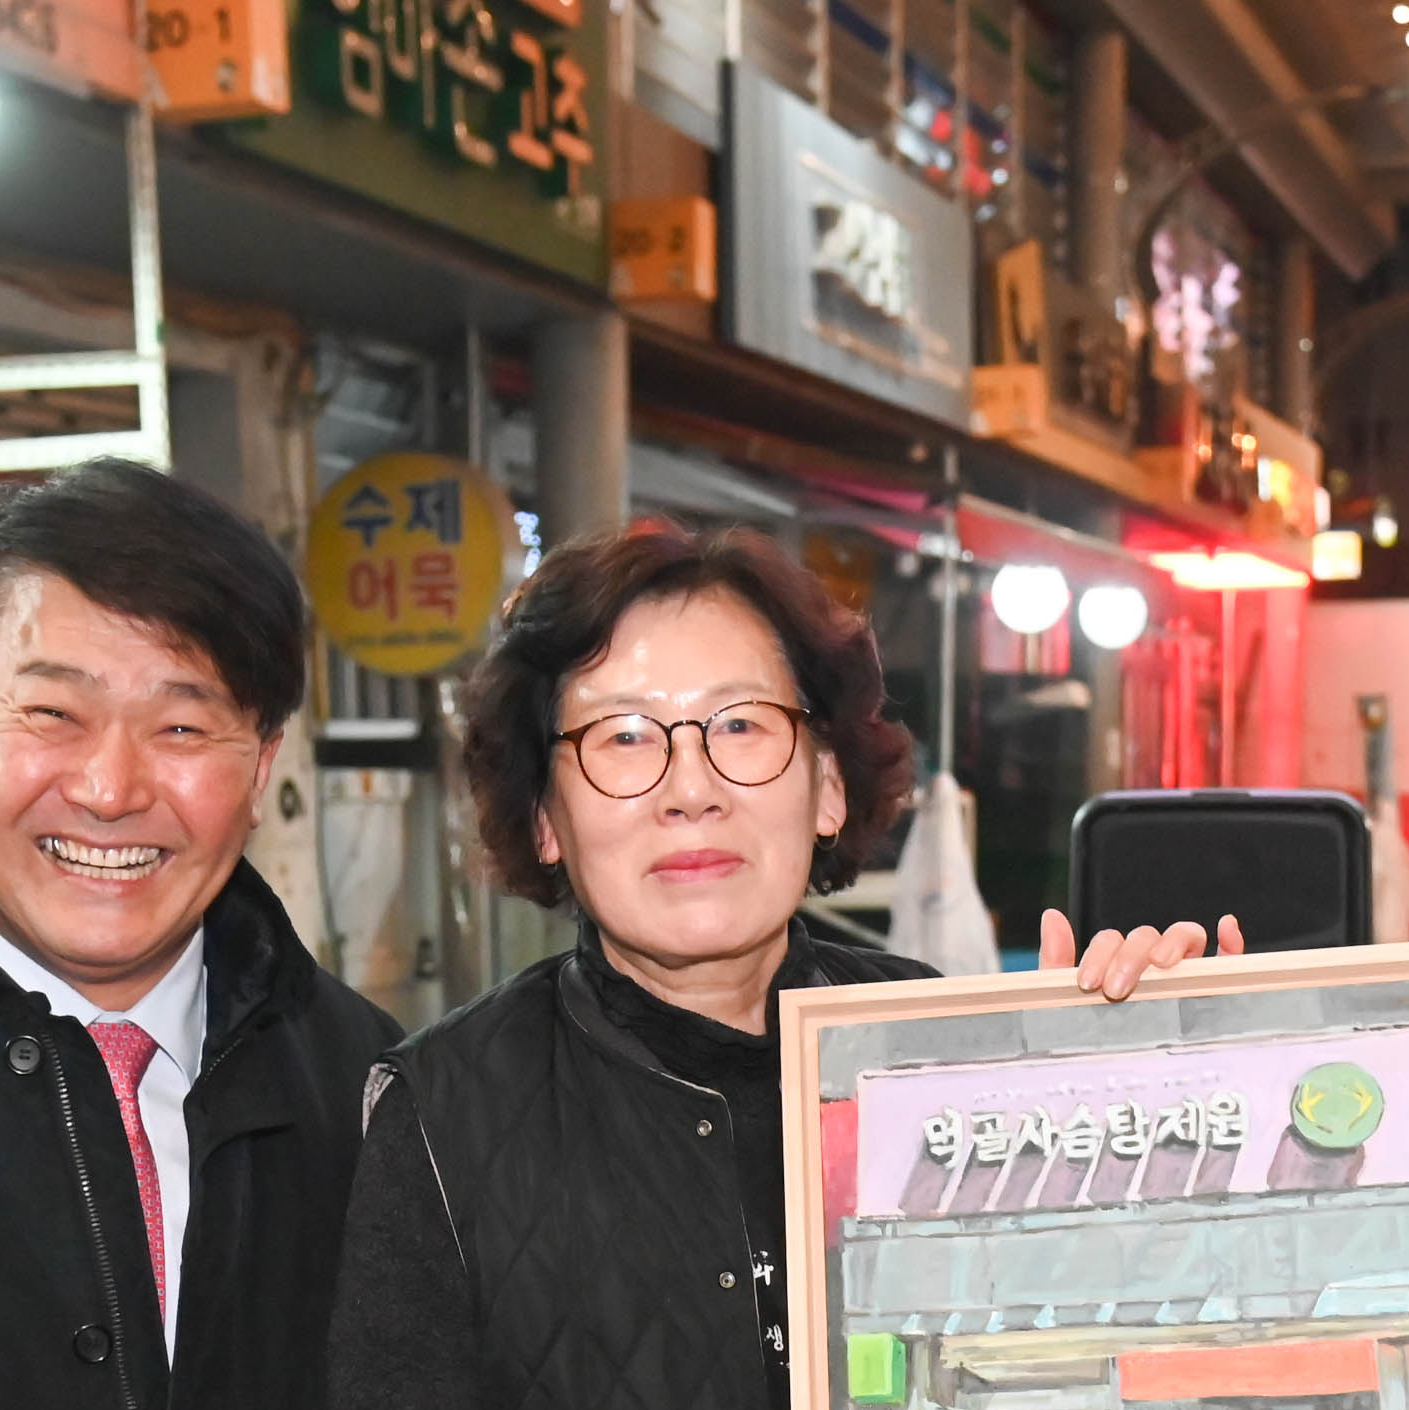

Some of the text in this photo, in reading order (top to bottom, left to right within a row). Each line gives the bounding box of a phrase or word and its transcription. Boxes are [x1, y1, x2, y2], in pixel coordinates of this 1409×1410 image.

[343, 481, 466, 549] 수제
[347, 551, 460, 623] 어묵
[922, 1089, 1249, 1170] 먹골사슴탕제원
